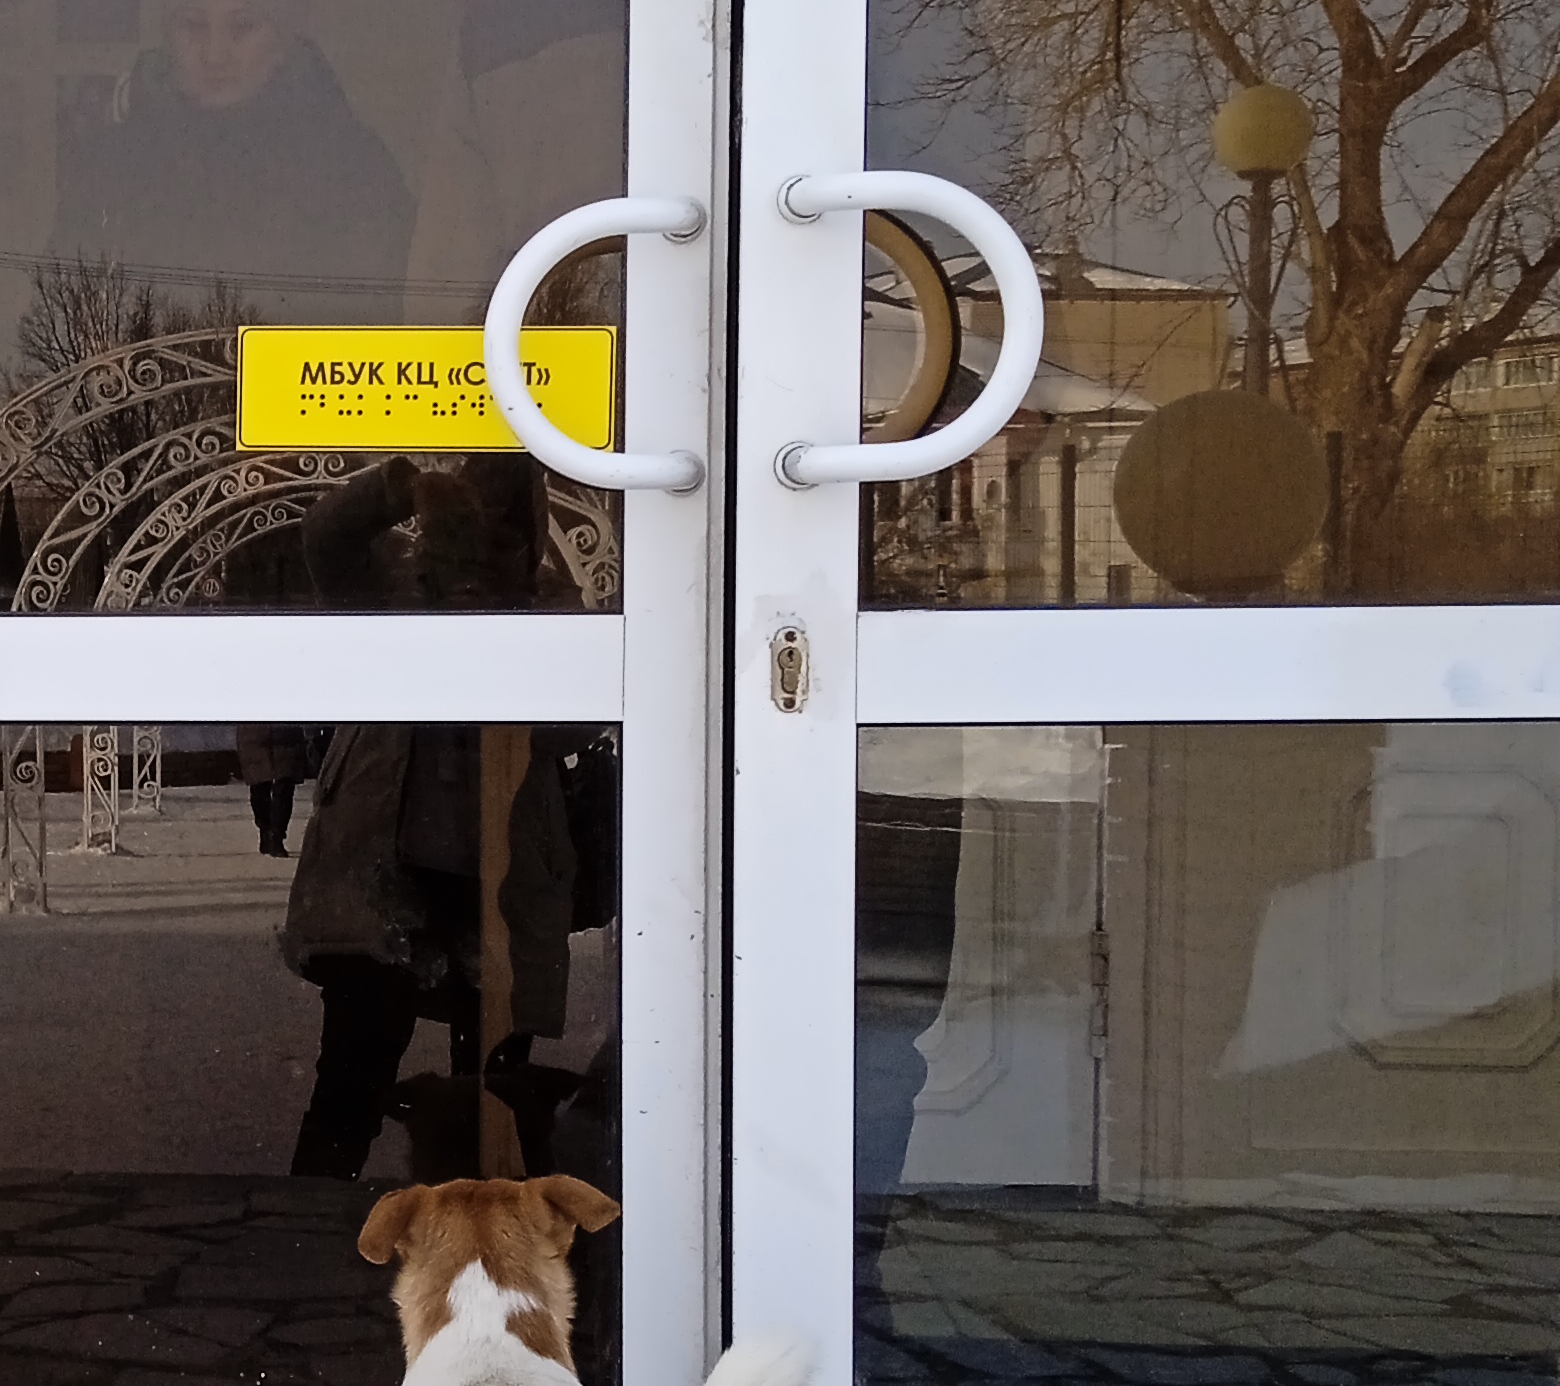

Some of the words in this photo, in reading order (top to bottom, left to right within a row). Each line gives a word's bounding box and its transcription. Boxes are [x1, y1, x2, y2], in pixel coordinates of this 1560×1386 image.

[300, 361, 385, 386] МБУК
[396, 361, 439, 389] КЦ
[448, 361, 551, 387] «СТ»
